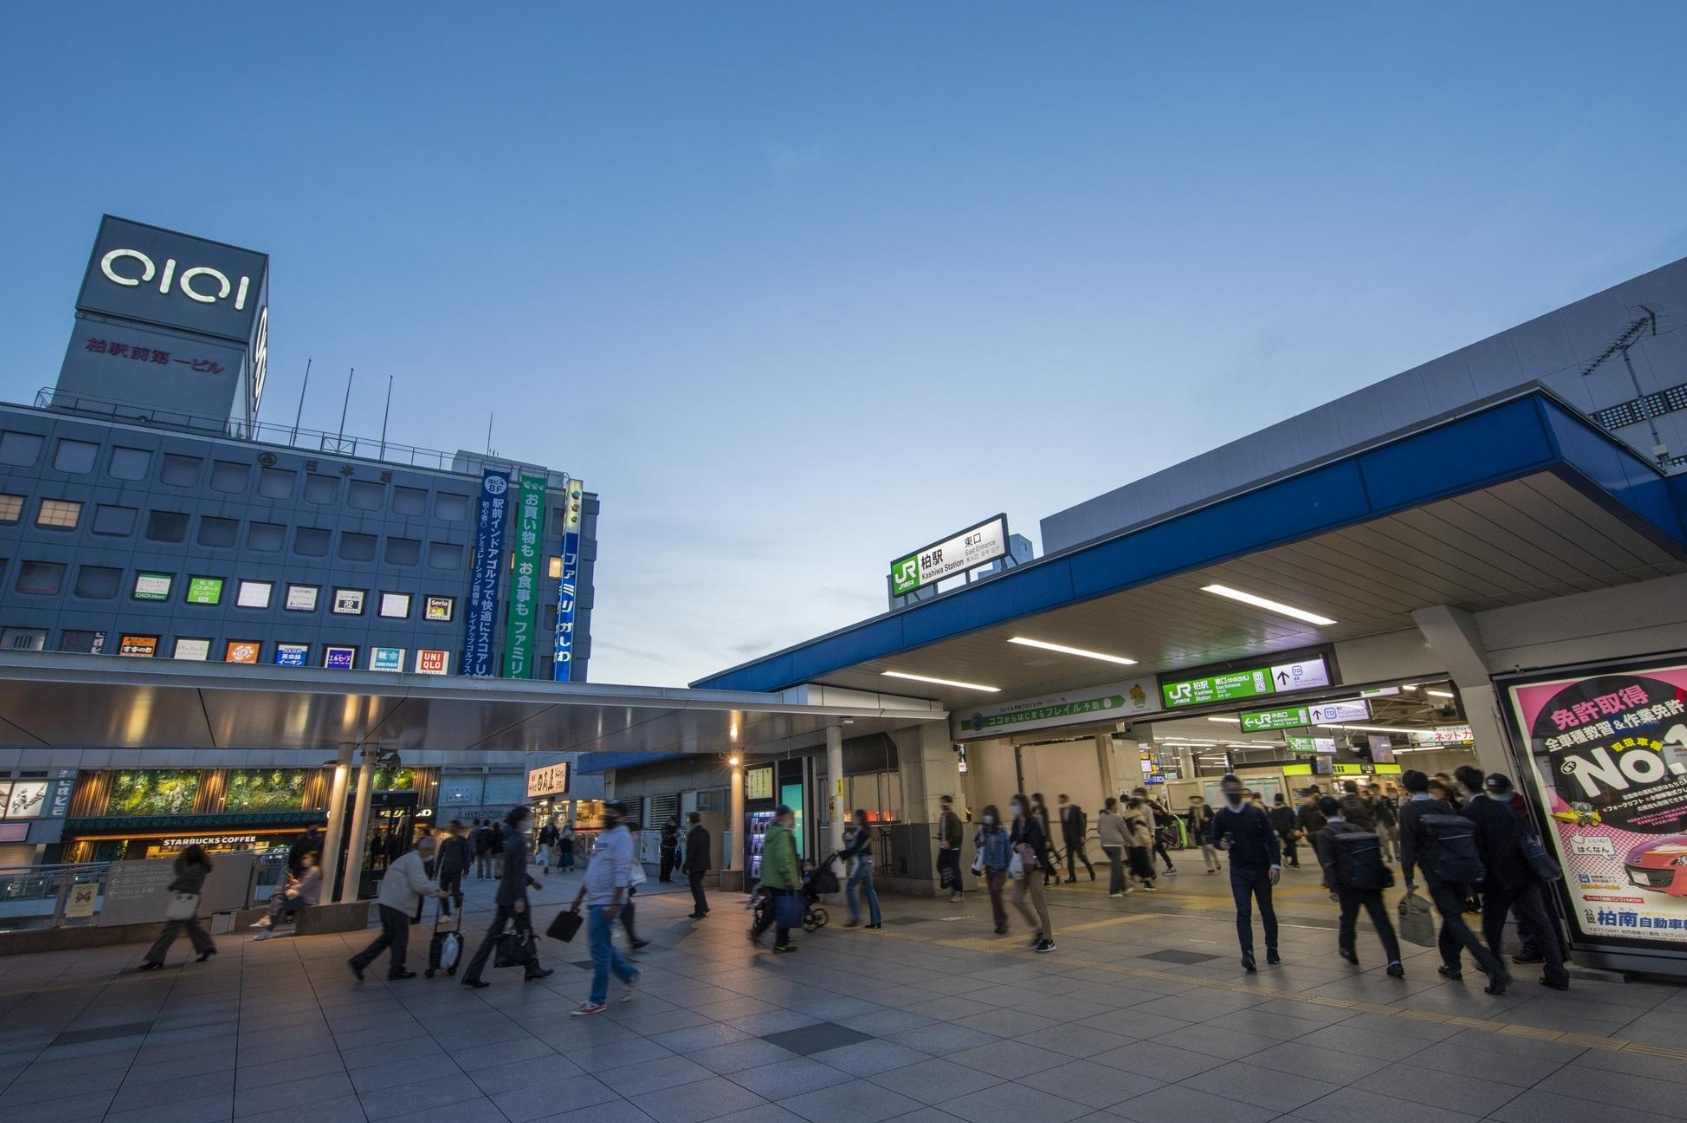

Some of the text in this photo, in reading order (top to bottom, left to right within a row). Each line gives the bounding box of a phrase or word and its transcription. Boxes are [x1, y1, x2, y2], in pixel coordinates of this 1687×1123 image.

[85, 337, 225, 375] 柏駅前第一ビル
[488, 484, 503, 493] 8F
[964, 532, 981, 548] 東口
[965, 539, 996, 558] East Entrance
[921, 548, 943, 571] 柏駅
[895, 560, 917, 584] JR
[921, 559, 964, 581] Kashiwa Station
[510, 494, 539, 679] お買い物も お食事も ファミリ
[423, 661, 441, 669] QLO
[1169, 683, 1192, 700] JR
[1193, 680, 1208, 690] 柏駅
[1551, 685, 1649, 730] 免許取得
[1255, 714, 1272, 725] JR
[163, 837, 220, 845] STARBUCKS
[1597, 910, 1687, 930] 柏南自動車
